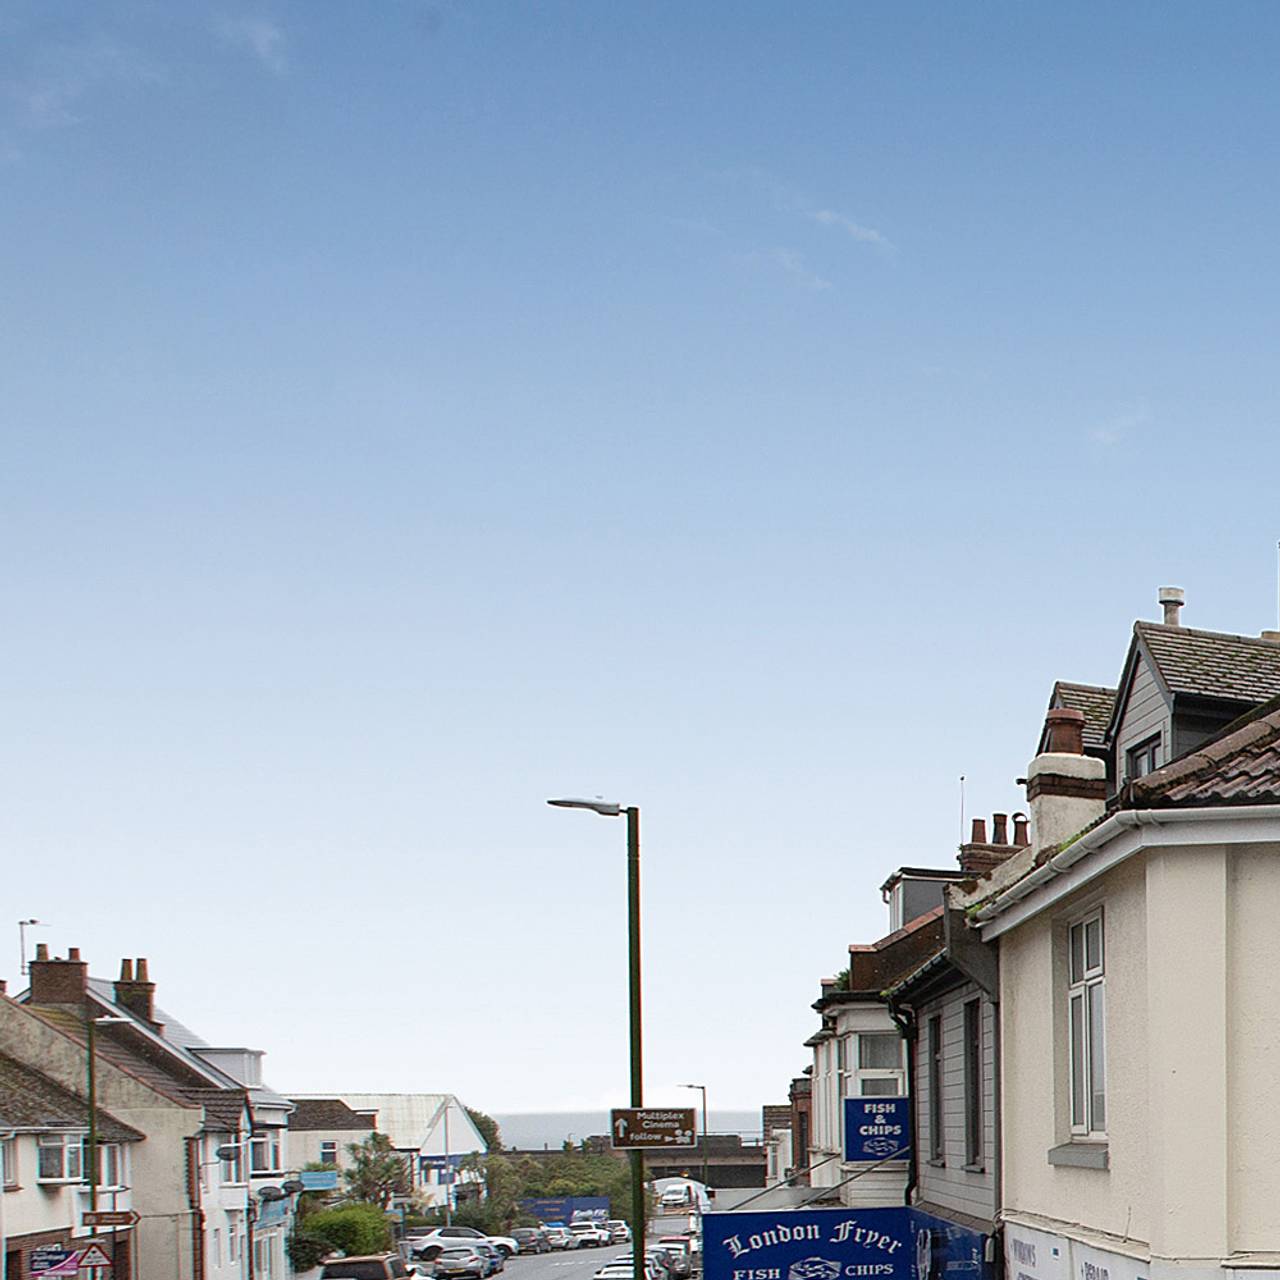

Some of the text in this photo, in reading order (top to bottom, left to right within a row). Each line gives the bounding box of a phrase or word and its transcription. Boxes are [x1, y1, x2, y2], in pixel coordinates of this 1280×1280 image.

[863, 1103, 896, 1114] FISH
[636, 1112, 685, 1121] Multiplex
[874, 1114, 886, 1125] &
[642, 1120, 680, 1129] Cinema
[859, 1125, 902, 1136] CHIPS
[629, 1132, 662, 1141] follow
[722, 1220, 903, 1260] London Fryer
[733, 1263, 894, 1280] FISH CHIPS
